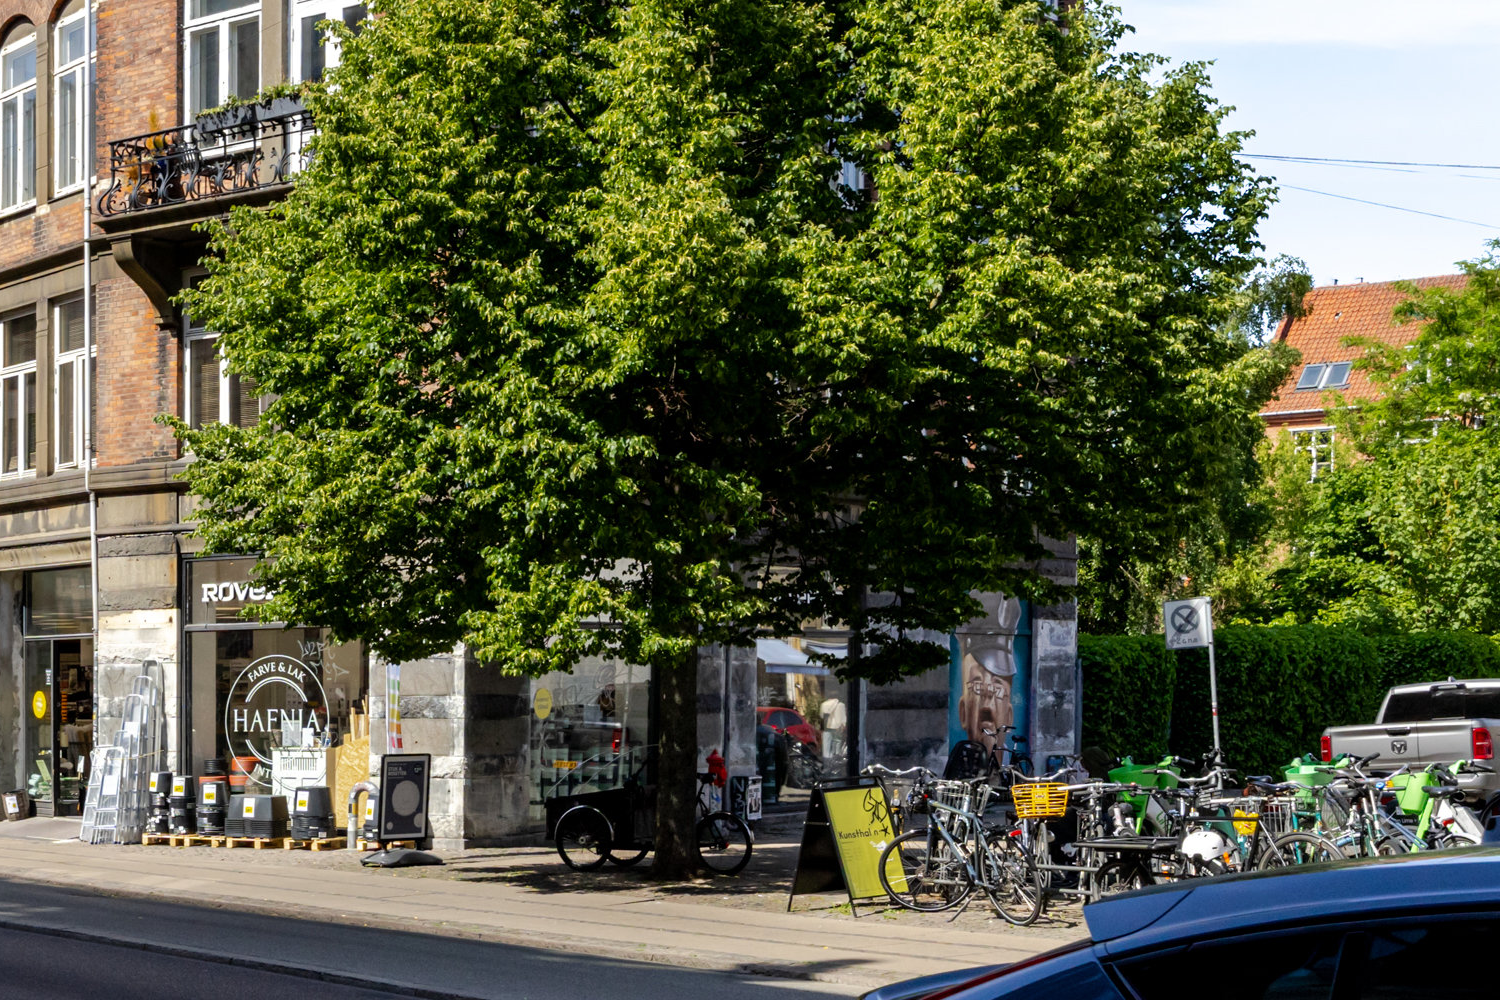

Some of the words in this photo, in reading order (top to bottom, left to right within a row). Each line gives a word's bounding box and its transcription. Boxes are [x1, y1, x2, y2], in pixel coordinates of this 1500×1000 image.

[247, 661, 276, 683] FARVE
[277, 662, 286, 673] &
[287, 664, 307, 683] LAK
[233, 708, 321, 733] HAFNIA
[253, 763, 273, 779] INT
[838, 828, 872, 840] Kunsthal
